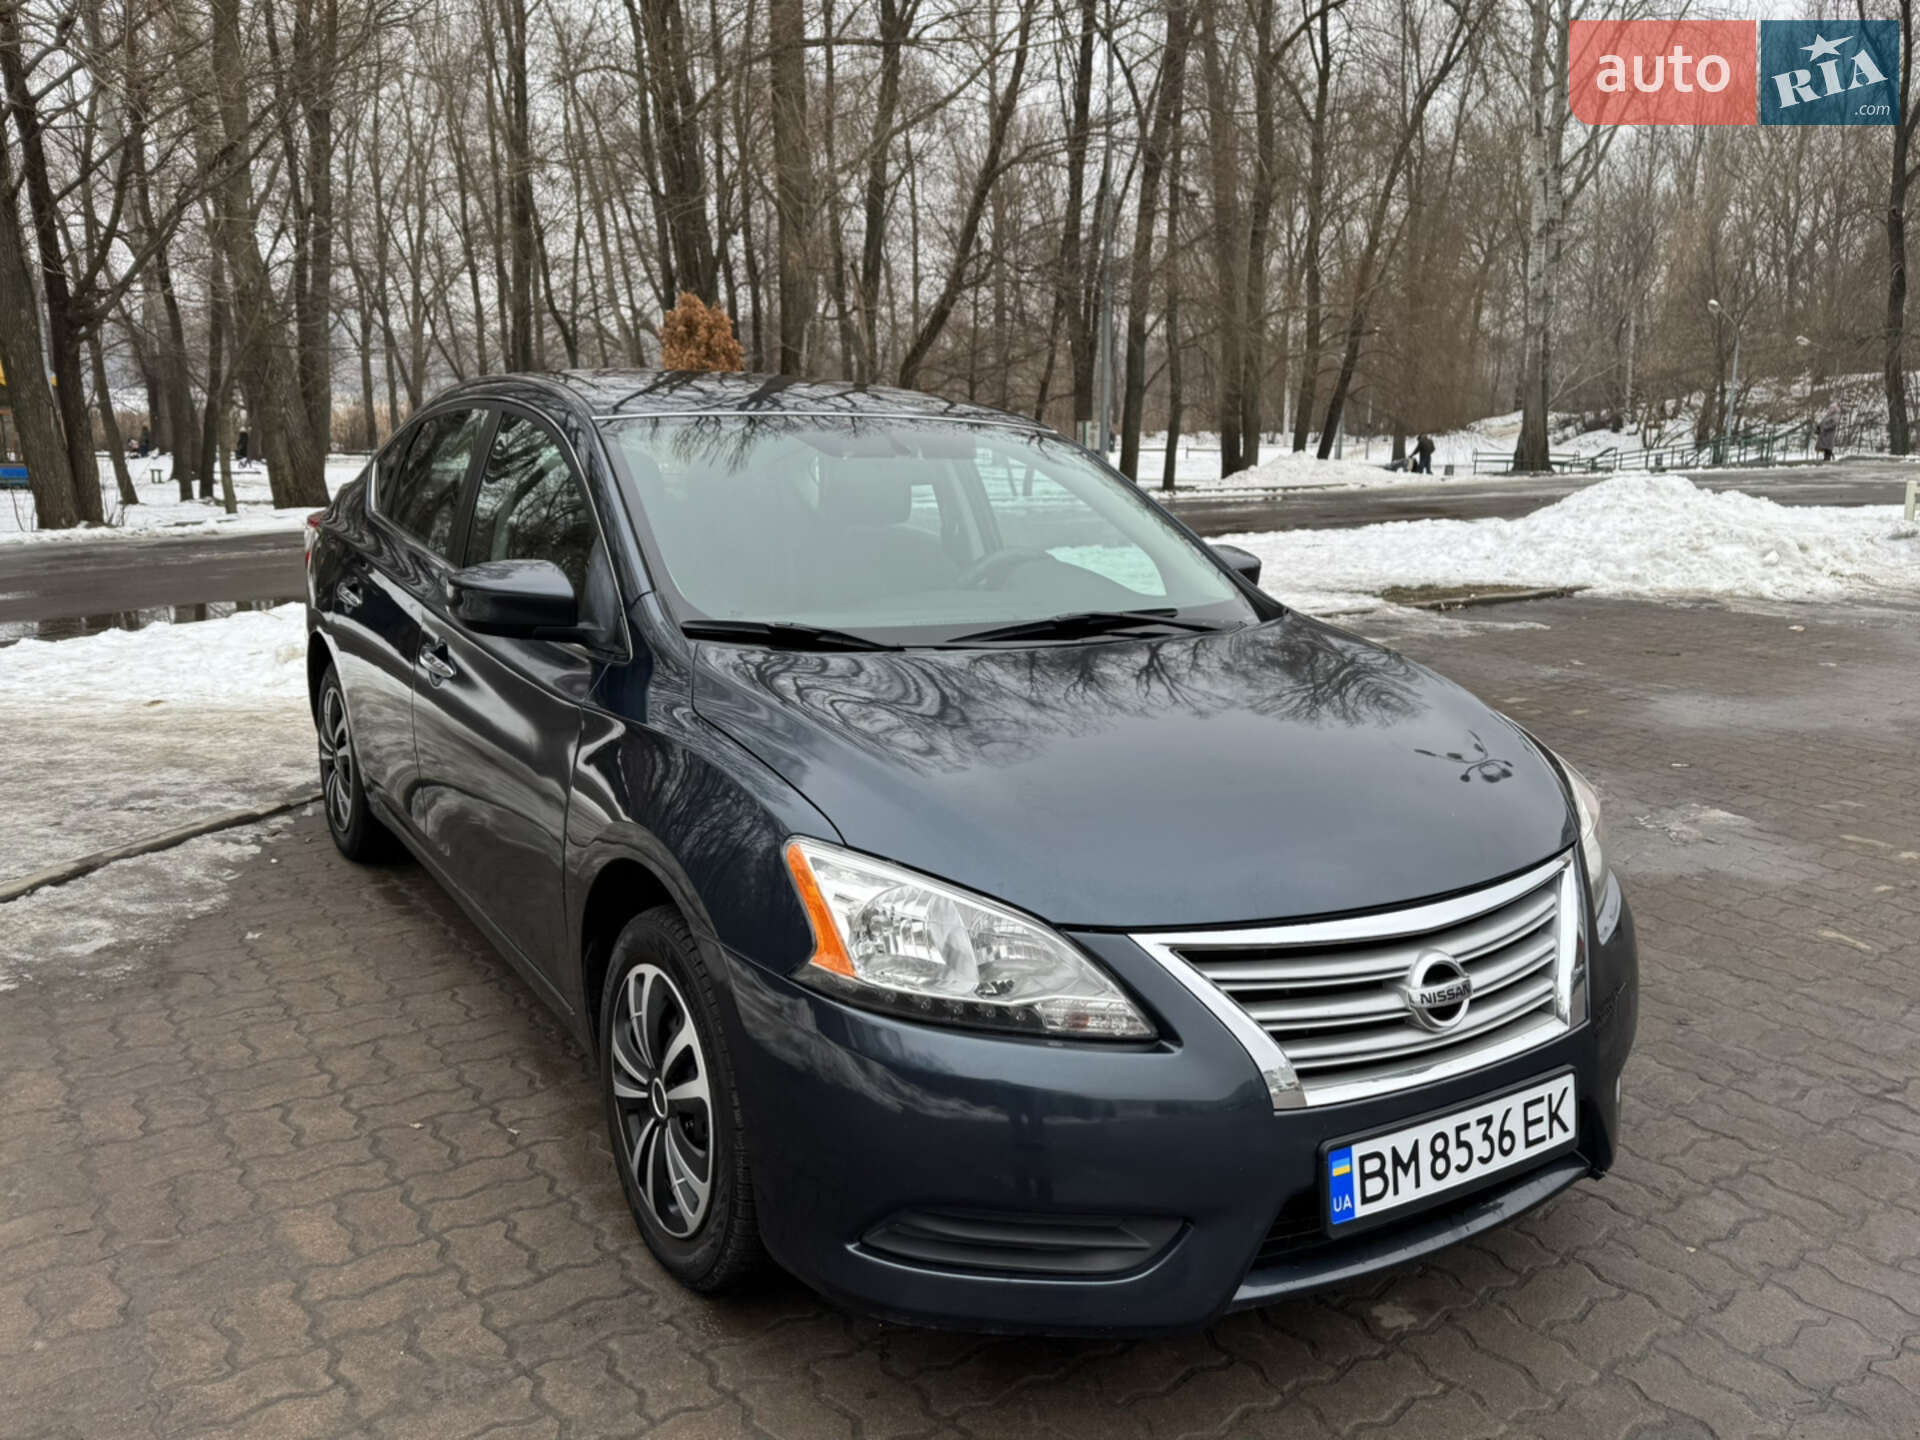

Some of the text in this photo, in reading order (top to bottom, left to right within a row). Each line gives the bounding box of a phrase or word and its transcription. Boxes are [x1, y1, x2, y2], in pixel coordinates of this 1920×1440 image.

[1420, 982, 1471, 1005] NISSAN
[1358, 1086, 1570, 1206] BM 8536 EK
[1333, 1194, 1353, 1213] UA
